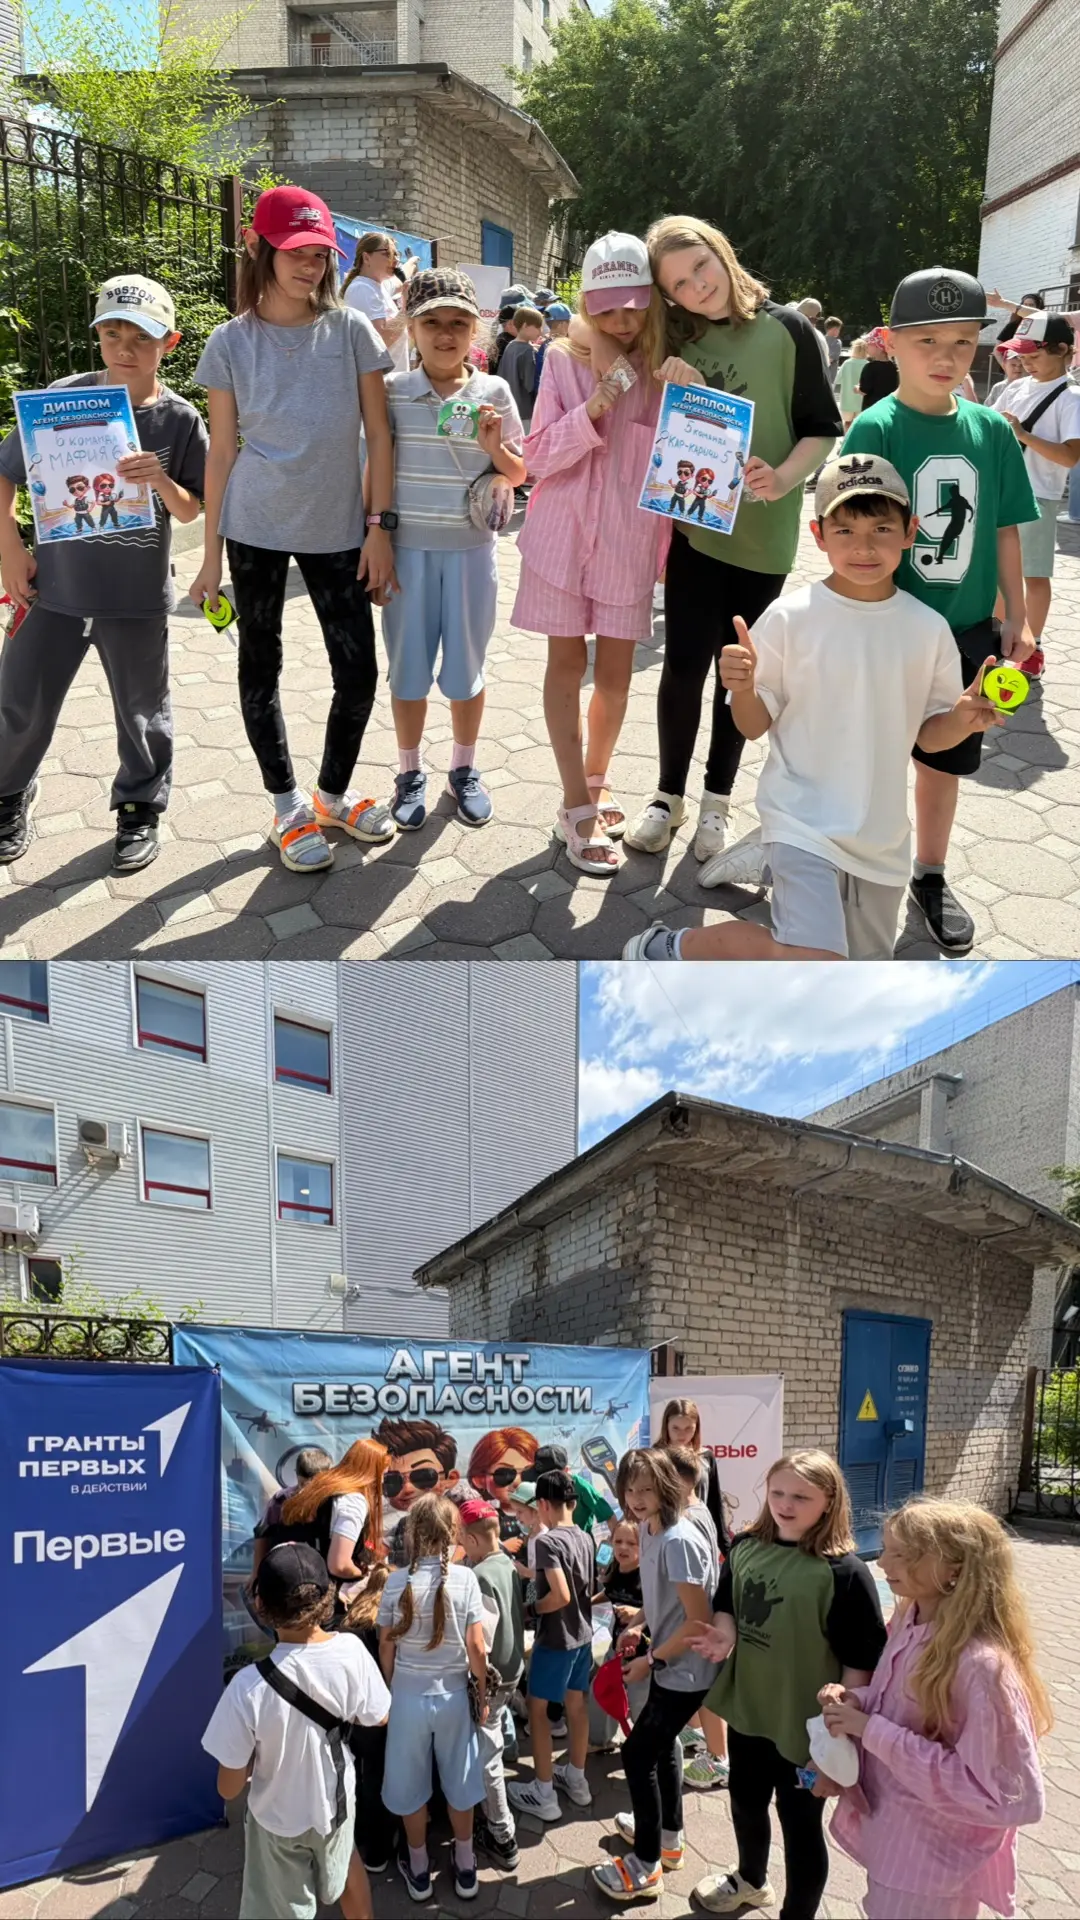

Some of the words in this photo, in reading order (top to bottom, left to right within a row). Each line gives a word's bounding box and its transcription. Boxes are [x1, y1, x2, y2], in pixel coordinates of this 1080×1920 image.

[106, 286, 156, 304] BOSTON
[941, 290, 952, 304] H
[43, 398, 110, 416] ДИПЛОМ
[682, 391, 736, 416] ДИПЛОМ
[32, 416, 58, 426] АГЕНТ
[61, 411, 122, 422] БЕЗОПАСНОСТИ
[672, 402, 693, 413] АГЕНТ
[694, 406, 744, 428] БЕЗОПАСНОСТИ
[684, 420, 695, 433] 5
[49, 445, 108, 471] МАФИЯ
[720, 450, 733, 464] 5
[837, 475, 883, 490] adidas
[910, 454, 979, 584] 9
[385, 1349, 530, 1383] АГЕНТ
[292, 1383, 593, 1414] БЕЗОПАСНОСТИ
[28, 1436, 145, 1452] ГРАНТЫ
[19, 1459, 146, 1477] ПЕРВЫХ
[71, 1485, 79, 1494] В
[82, 1482, 147, 1495] ДЕЙСТВИИ
[14, 1528, 186, 1570] Первые
